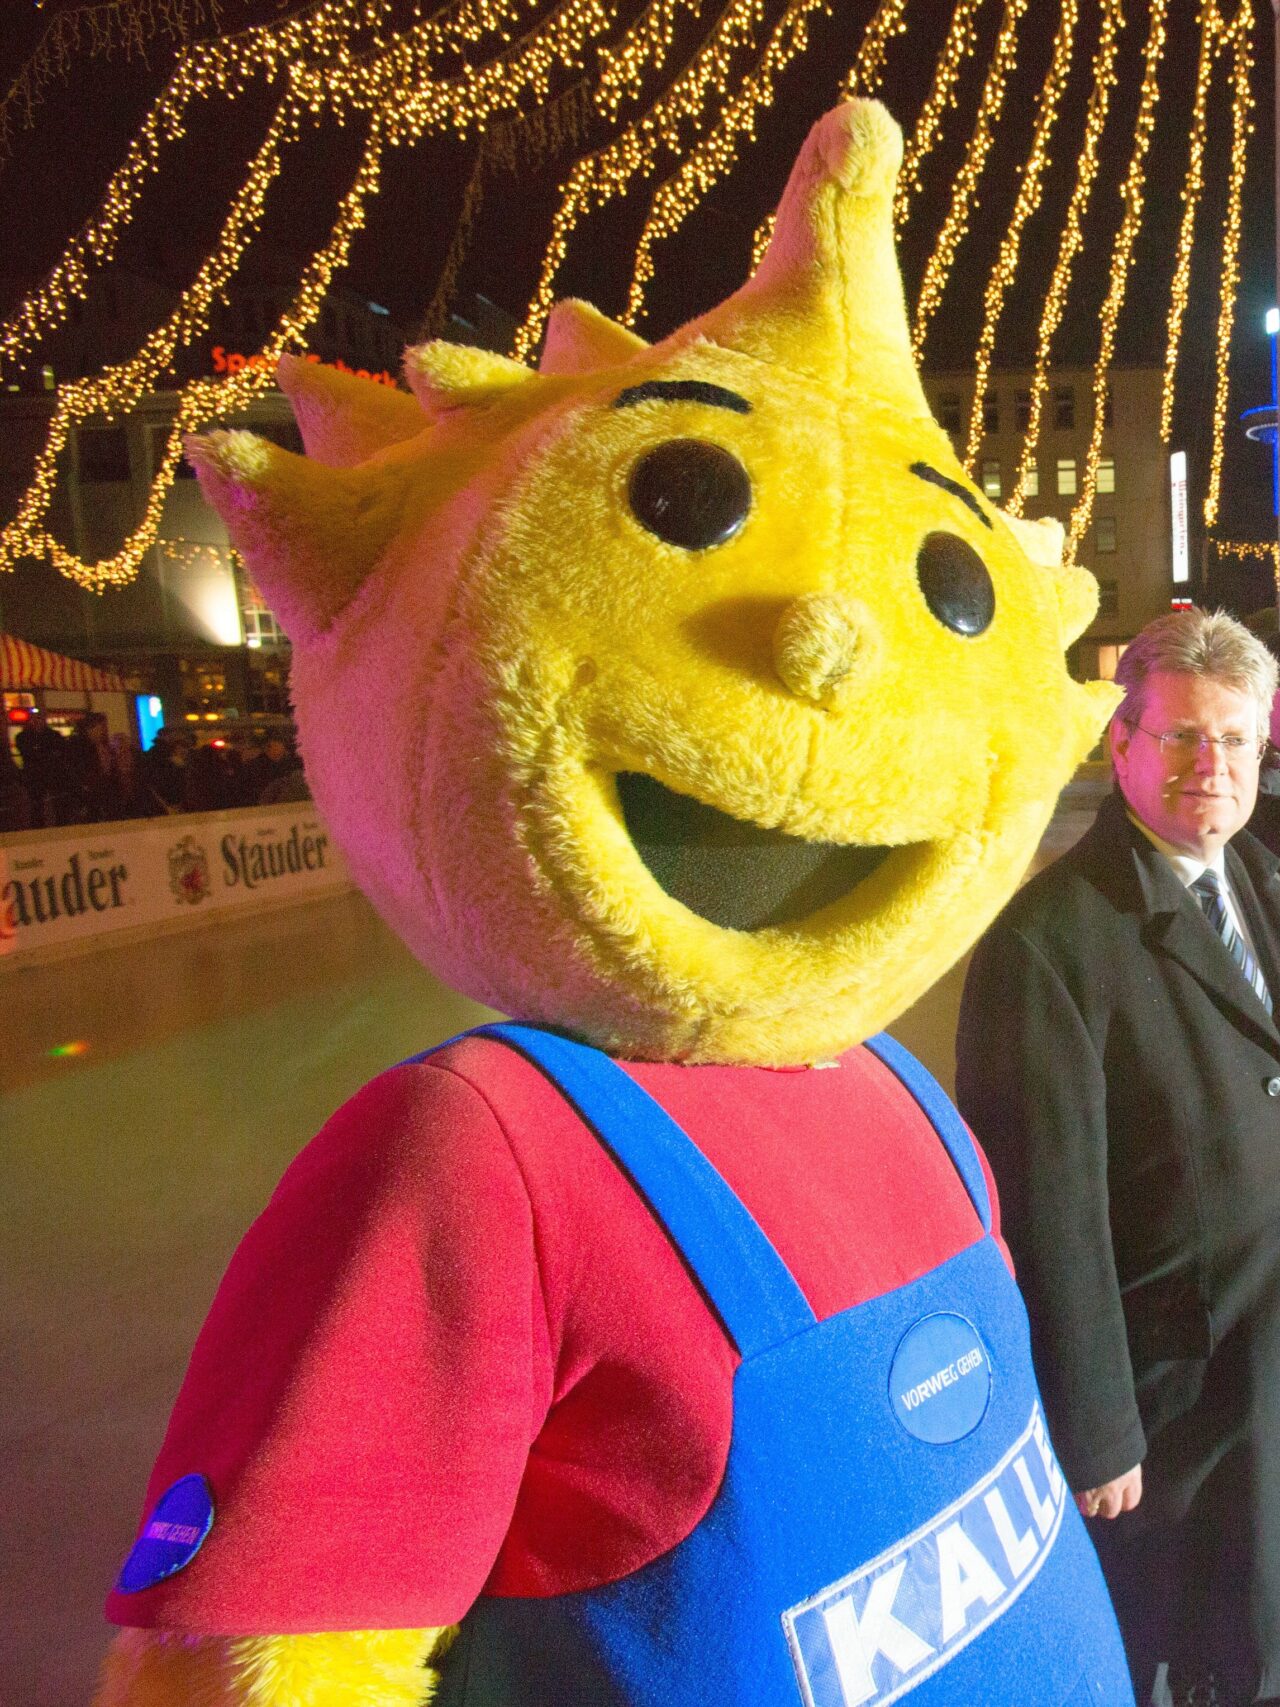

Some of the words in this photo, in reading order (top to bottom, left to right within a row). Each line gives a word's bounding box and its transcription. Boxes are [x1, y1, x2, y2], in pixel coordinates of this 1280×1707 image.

[220, 824, 328, 889] Stauder
[0, 853, 128, 939] auder
[901, 1363, 959, 1411] VORWEG
[956, 1347, 984, 1376] GEHEN
[822, 1413, 1064, 1706] KALLE
